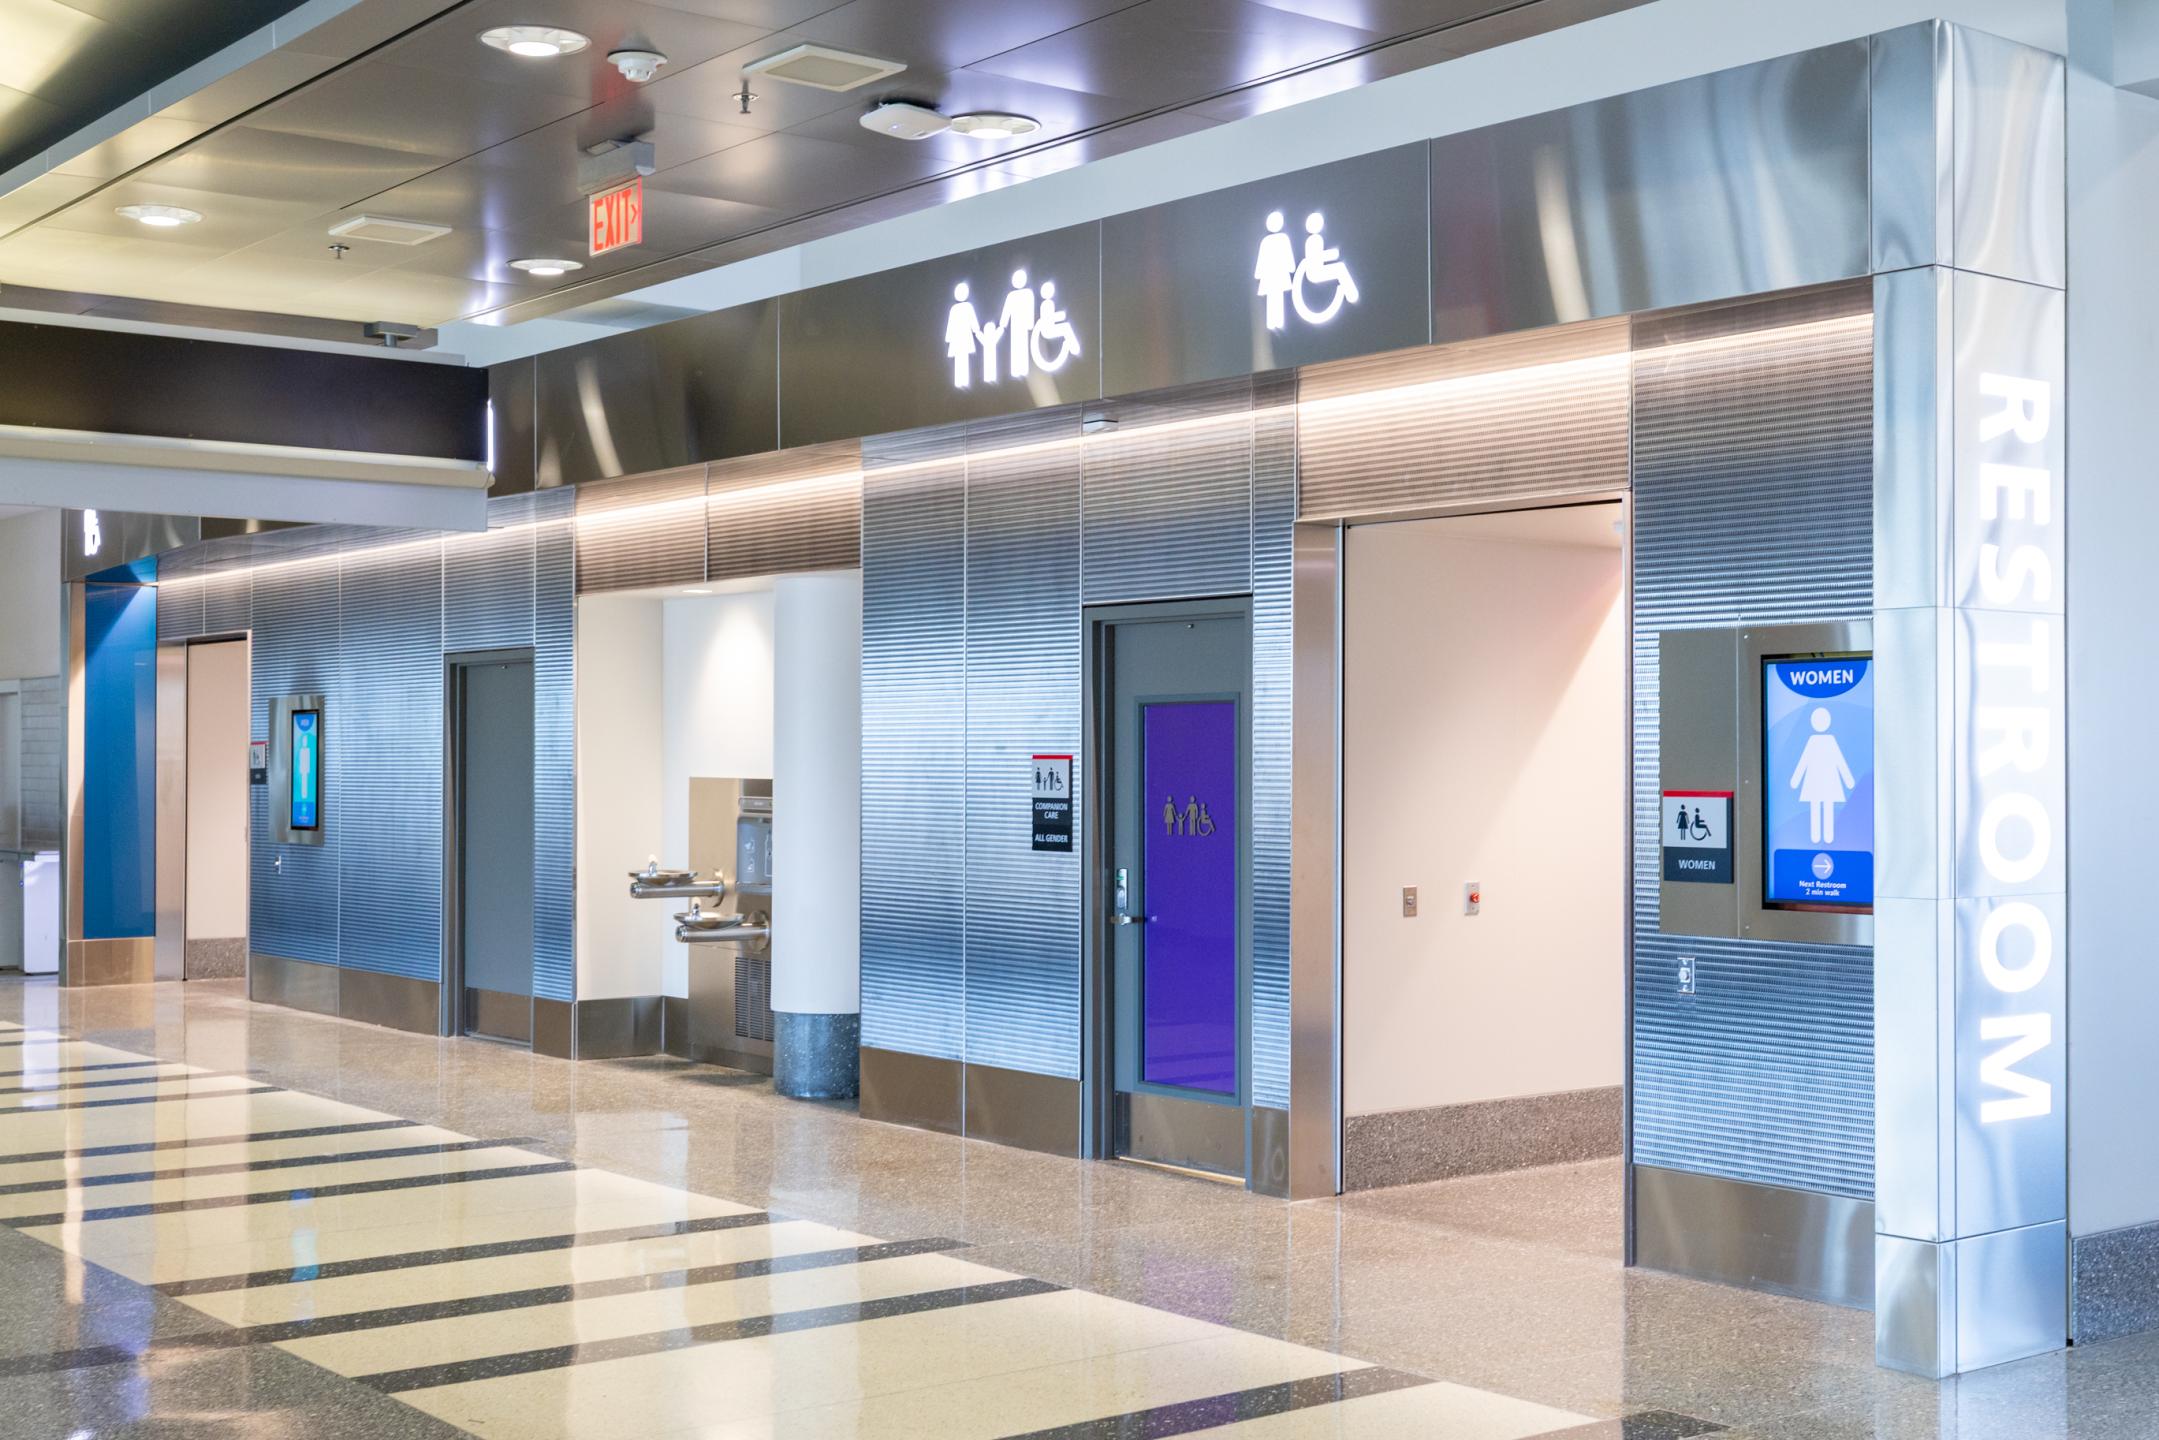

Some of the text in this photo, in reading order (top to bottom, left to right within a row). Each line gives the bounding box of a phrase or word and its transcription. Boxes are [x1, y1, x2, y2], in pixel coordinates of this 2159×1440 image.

[594, 188, 632, 251] EXIT
[1790, 670, 1854, 686] WOMEN
[1977, 370, 2053, 1126] RESTROOM
[1035, 802, 1068, 811] COMPANION
[1044, 811, 1059, 819] CARE
[1035, 833, 1068, 843] ALL GENDER
[1678, 859, 1716, 870] WOMEN
[1799, 880, 1847, 889] Next Restroom
